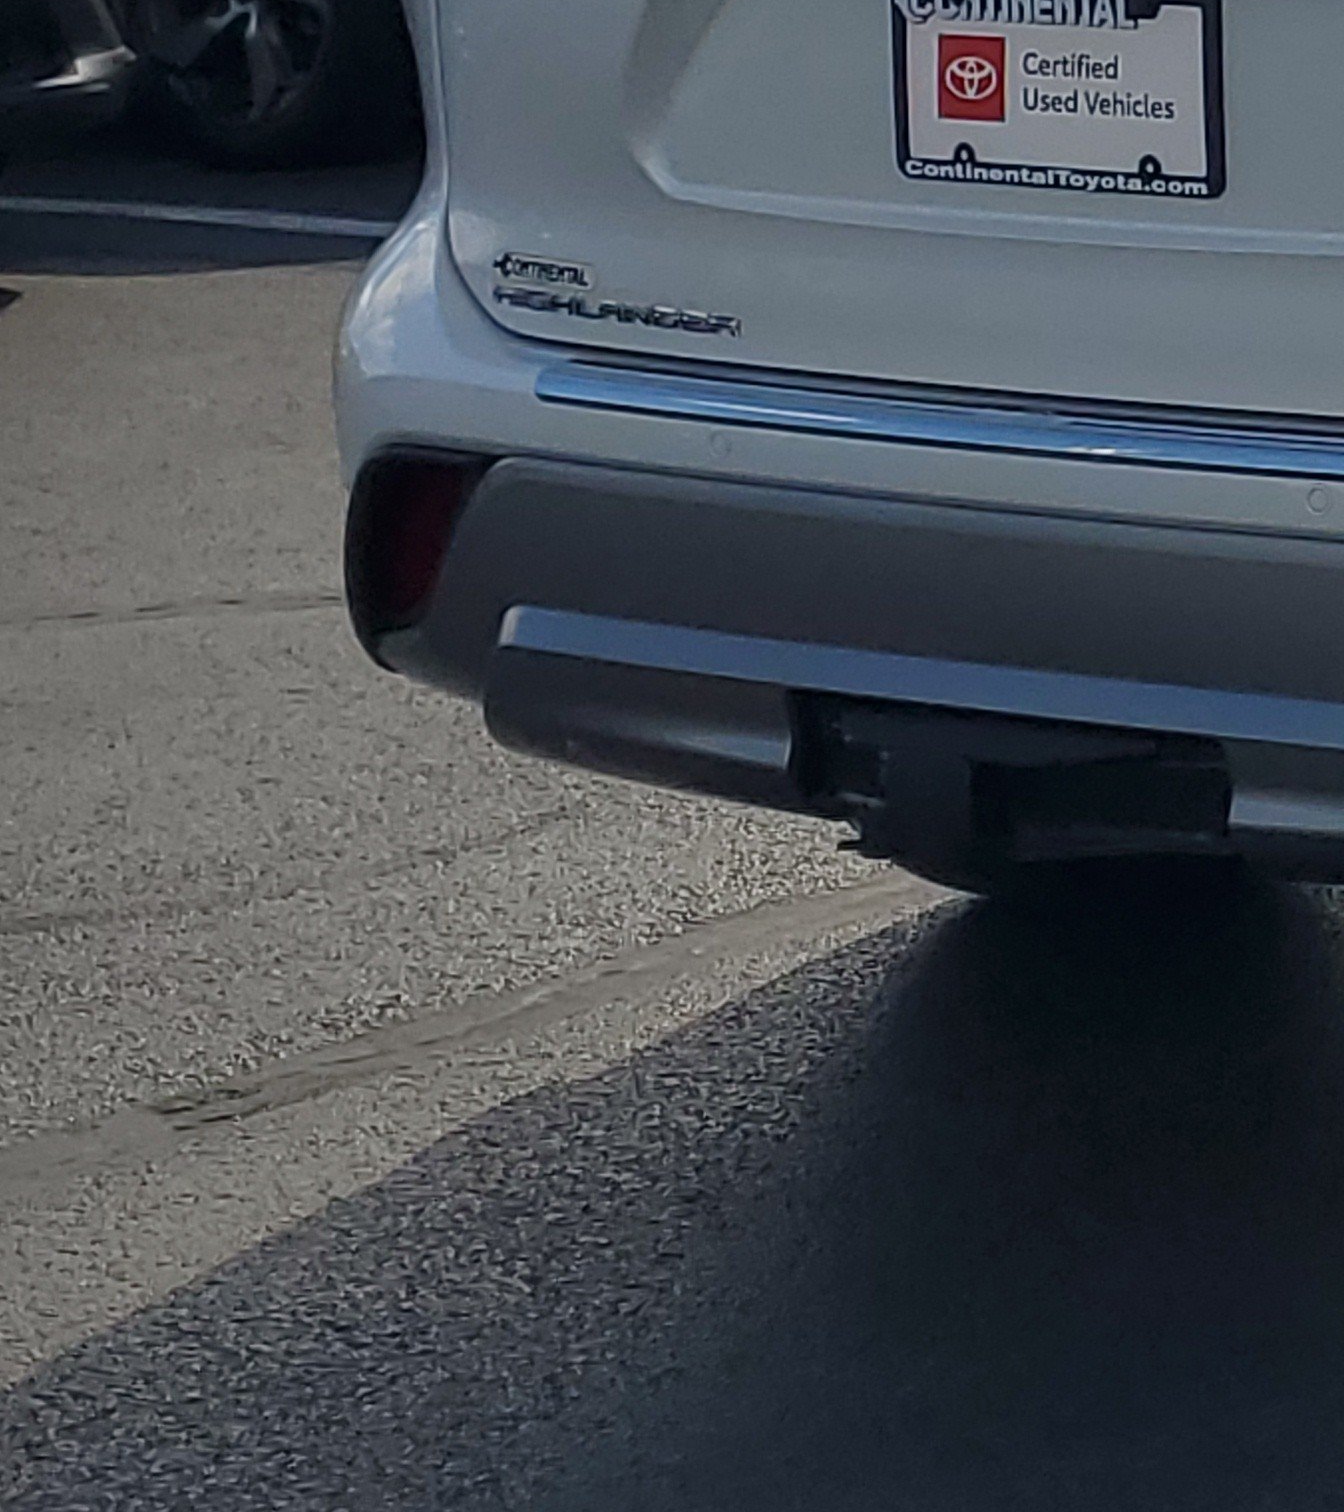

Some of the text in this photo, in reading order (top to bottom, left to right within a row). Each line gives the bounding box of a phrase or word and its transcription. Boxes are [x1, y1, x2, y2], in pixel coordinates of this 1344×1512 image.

[1022, 52, 1119, 79] Certified
[1023, 88, 1175, 119] Used Vehicles
[905, 159, 1208, 196] ContinentalToyota.com
[496, 253, 589, 287] CONTINENTAL
